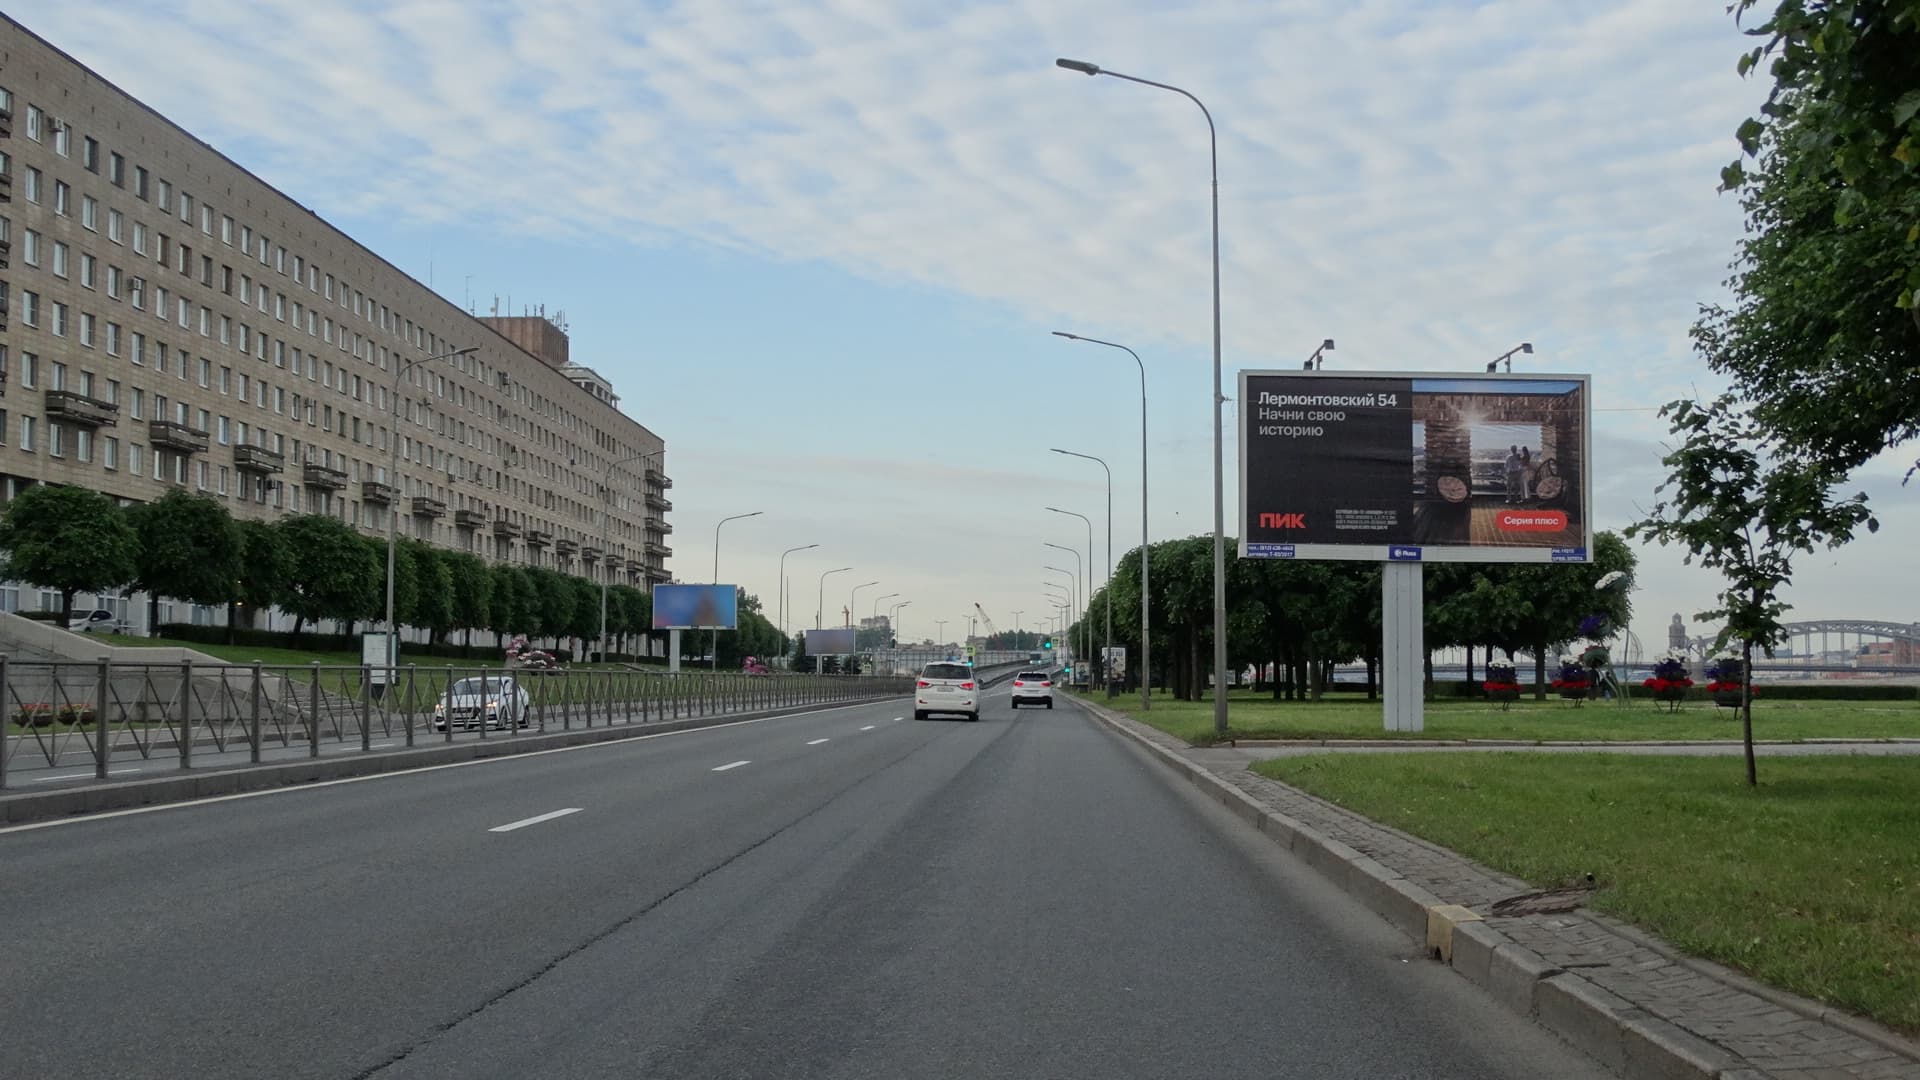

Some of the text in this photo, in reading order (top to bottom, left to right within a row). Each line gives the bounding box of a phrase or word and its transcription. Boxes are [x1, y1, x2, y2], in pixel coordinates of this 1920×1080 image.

[1258, 391, 1398, 408] Лермонтовский 54
[1258, 407, 1346, 422] Начни свою
[1259, 425, 1324, 438] историю
[1259, 512, 1307, 529] ПИК
[1503, 516, 1559, 526] Серия плюс
